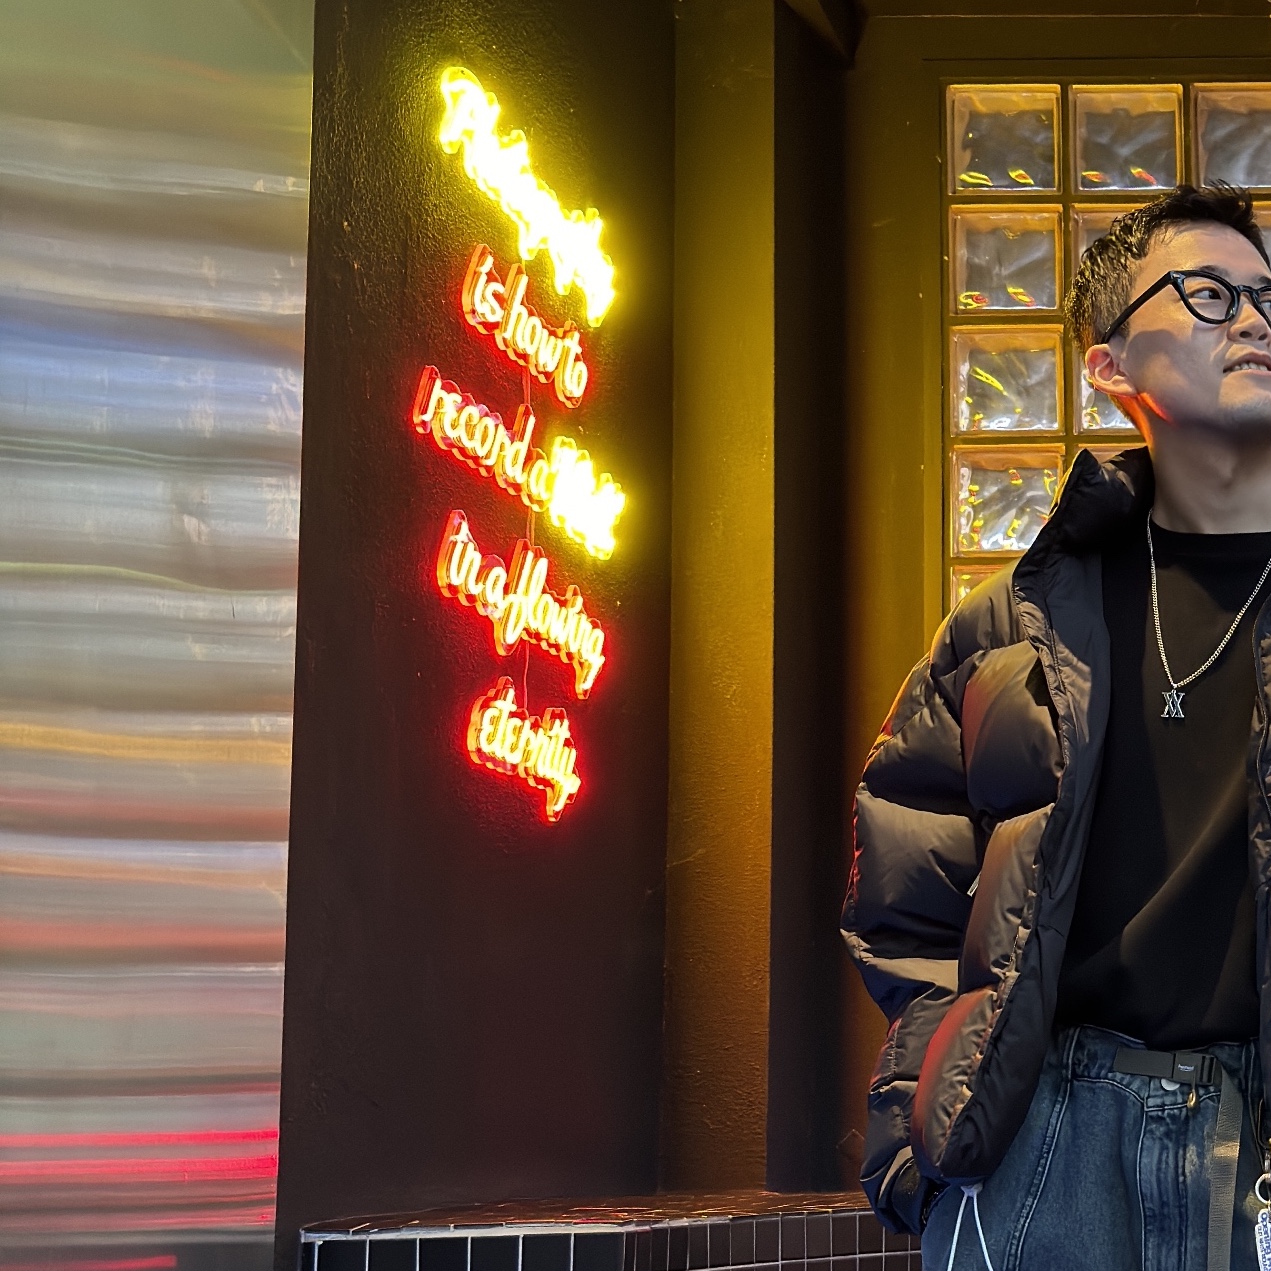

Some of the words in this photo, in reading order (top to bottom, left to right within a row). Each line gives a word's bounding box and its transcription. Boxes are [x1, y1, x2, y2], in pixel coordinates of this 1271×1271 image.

[473, 254, 505, 322] is
[502, 274, 562, 372] how
[563, 331, 588, 398] to
[420, 378, 535, 484] record
[529, 459, 550, 500] a
[450, 522, 485, 592] in
[486, 568, 509, 612] a
[503, 549, 606, 692] flowing
[479, 691, 581, 811] eternity
[1260, 1212, 1271, 1255] Opening
